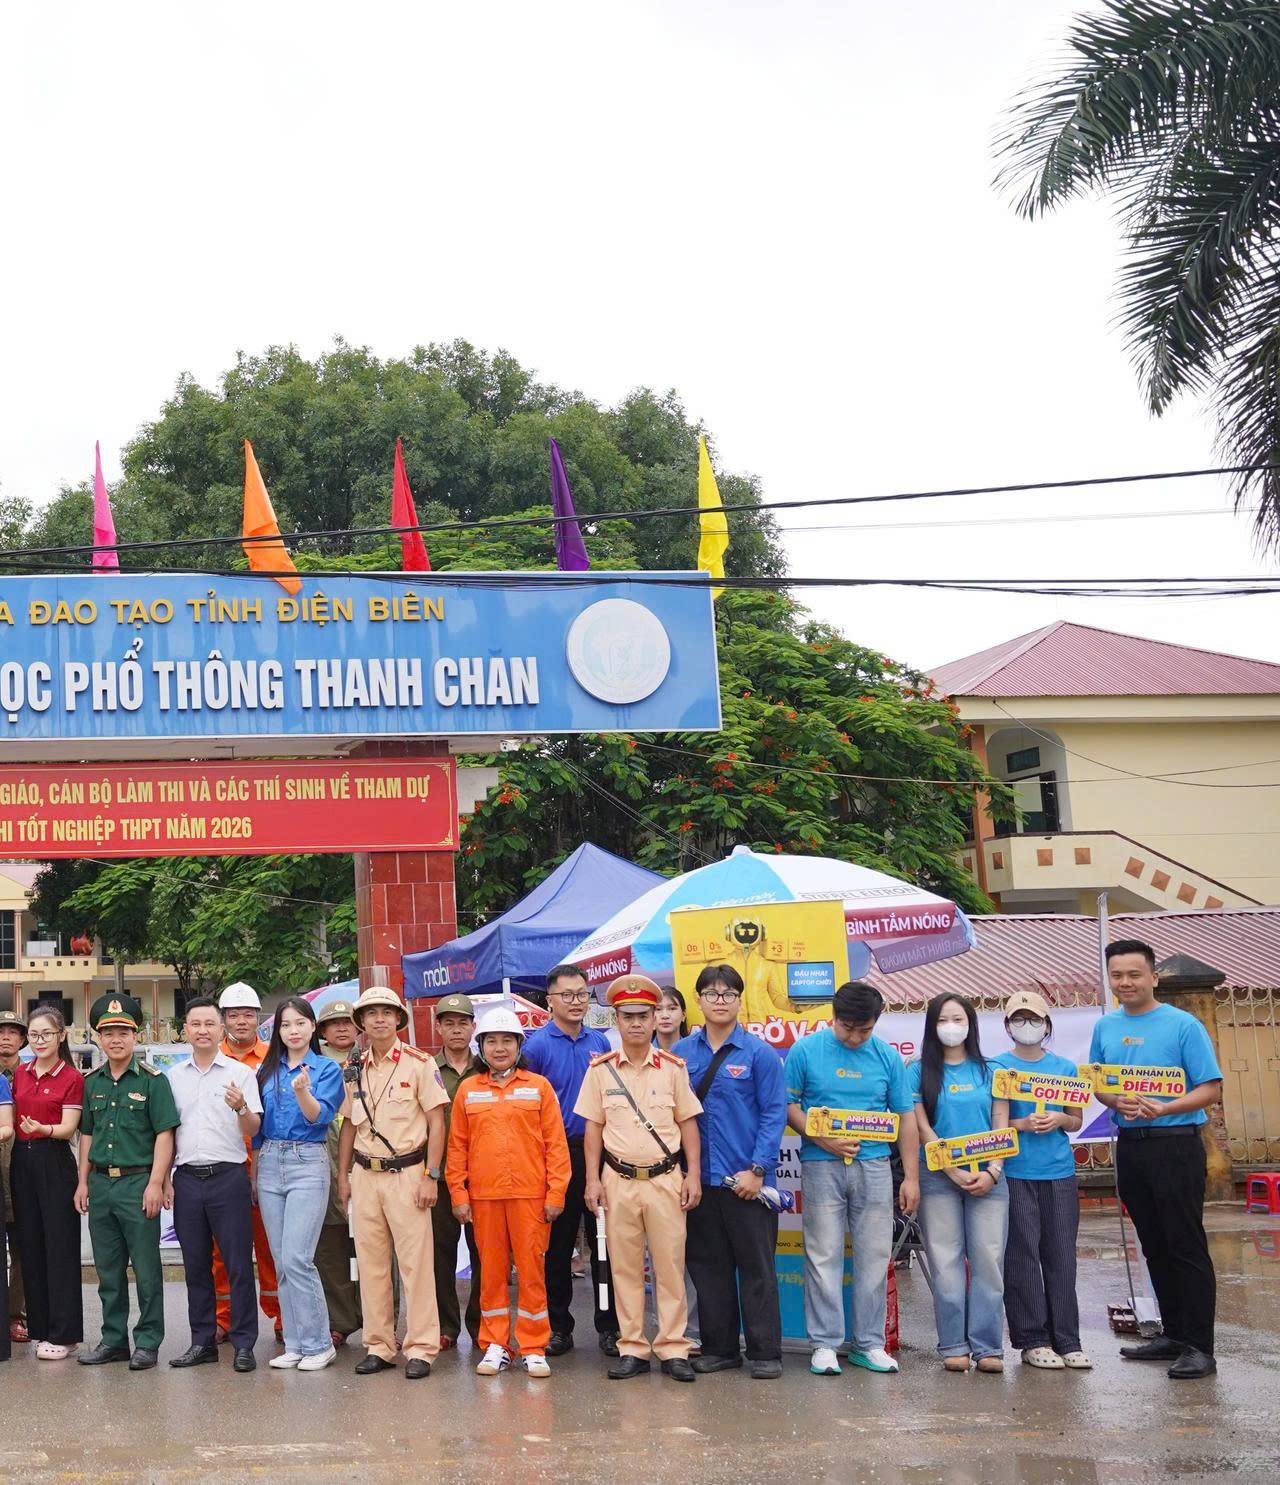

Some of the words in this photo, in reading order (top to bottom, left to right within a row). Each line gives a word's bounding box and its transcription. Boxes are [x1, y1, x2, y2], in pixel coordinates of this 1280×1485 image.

[110, 599, 174, 630] TẠO
[187, 588, 263, 623] TỈNH
[277, 591, 354, 627] ĐIỆN
[369, 592, 445, 622] BIÊN
[65, 637, 144, 711] PHỔ
[153, 649, 284, 711] THÔNG
[295, 658, 422, 708] THANH
[0, 779, 44, 807] GIÁO,
[49, 778, 84, 805] CÁN
[89, 778, 112, 809] BỘ
[117, 777, 153, 803] LÀM
[158, 780, 184, 802] THI
[189, 776, 211, 802] VÀ
[215, 775, 250, 801] CÁC
[254, 775, 280, 801] THÍ
[285, 779, 326, 800] SINH
[329, 771, 350, 800] VỀ
[354, 777, 402, 799] THAM
[407, 775, 430, 803] DỰ
[17, 812, 48, 842] TỐT
[52, 815, 115, 846] NGHIỆP
[120, 818, 160, 841] THPT
[166, 813, 206, 840] NĂM
[211, 817, 252, 839] 2026
[846, 915, 880, 935] BÌNH
[881, 912, 911, 932] TẮM
[912, 911, 950, 930] NÓNG
[423, 957, 476, 989] mobifone
[601, 957, 628, 977] NÓNG
[748, 1015, 786, 1043] BỜ
[1029, 1076, 1061, 1086] NGUYỆN
[1063, 1080, 1085, 1089] VỌNG
[1135, 1068, 1164, 1078] NHẬN
[1034, 1087, 1059, 1102] GỌI
[1063, 1088, 1090, 1104] TÊN
[1166, 1082, 1184, 1094] 10
[847, 1115, 865, 1123] ANH
[965, 1138, 983, 1147] ANH
